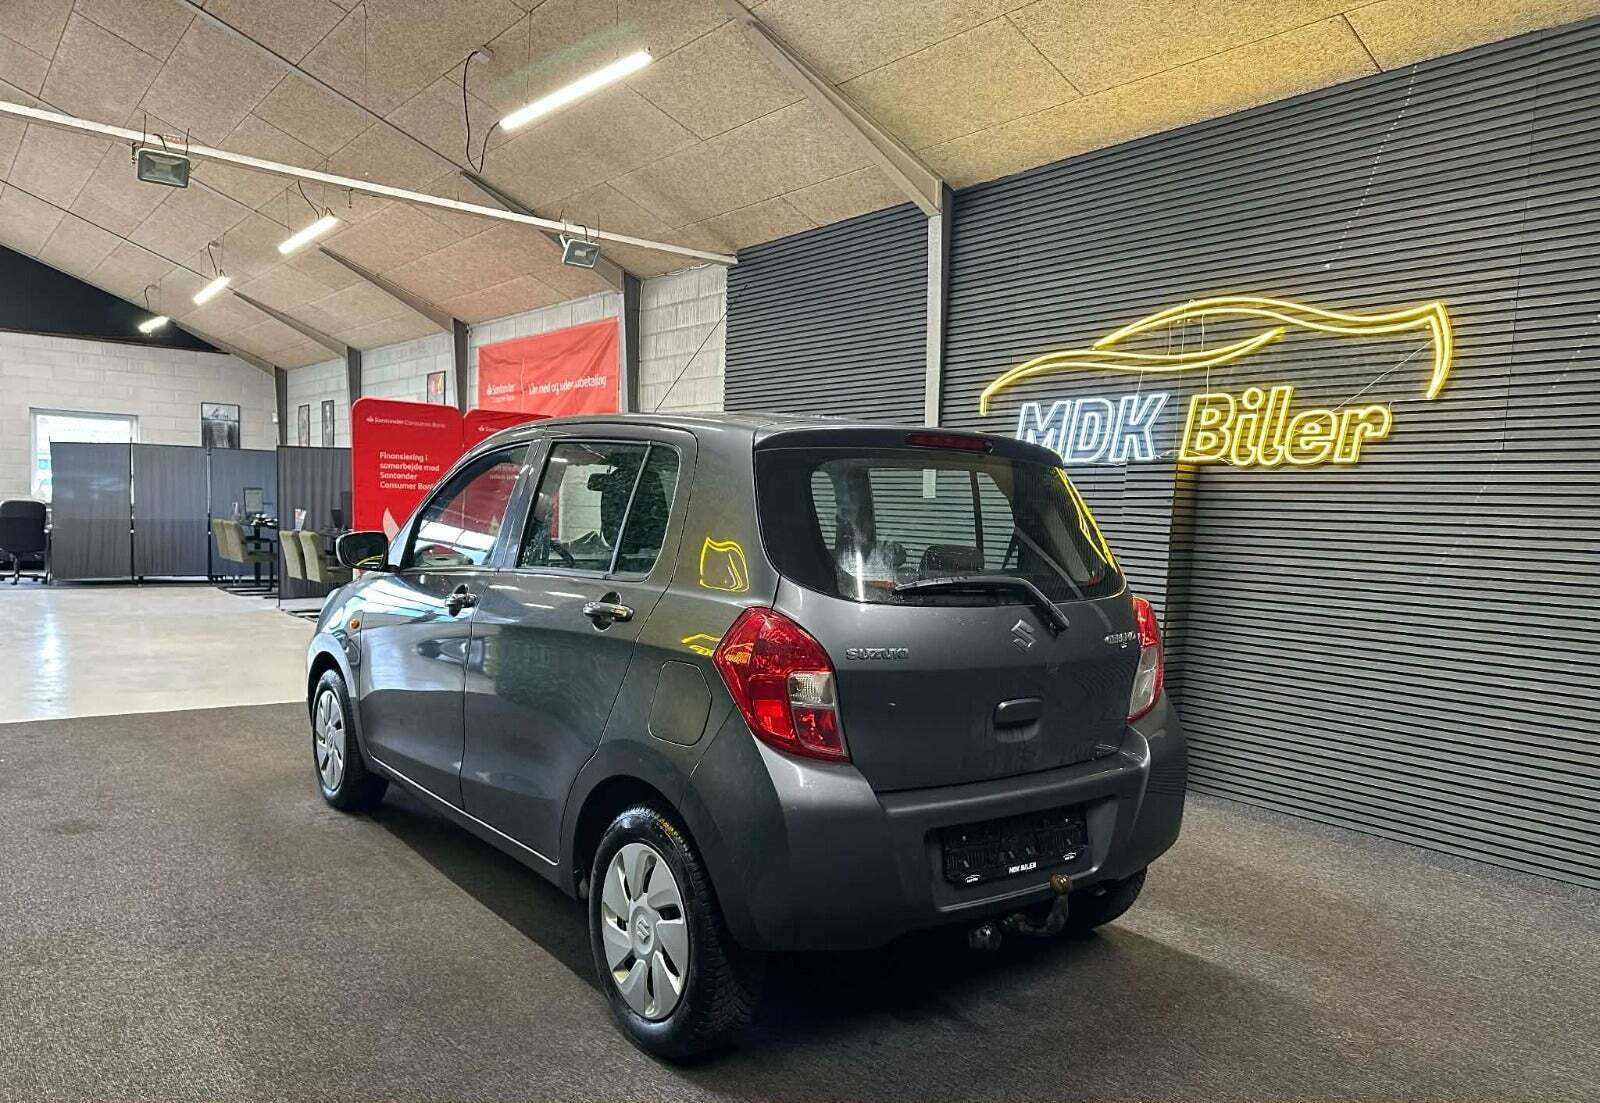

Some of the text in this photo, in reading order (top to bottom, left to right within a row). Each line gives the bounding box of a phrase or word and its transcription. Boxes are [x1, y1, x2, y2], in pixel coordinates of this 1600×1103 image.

[1016, 386, 1392, 466] MDK Biler
[379, 451, 424, 463] Finansiering
[379, 462, 440, 472] samarbejde med
[379, 471, 418, 480] Santander
[379, 480, 417, 490] Consumer
[845, 647, 910, 661] SUZUKI
